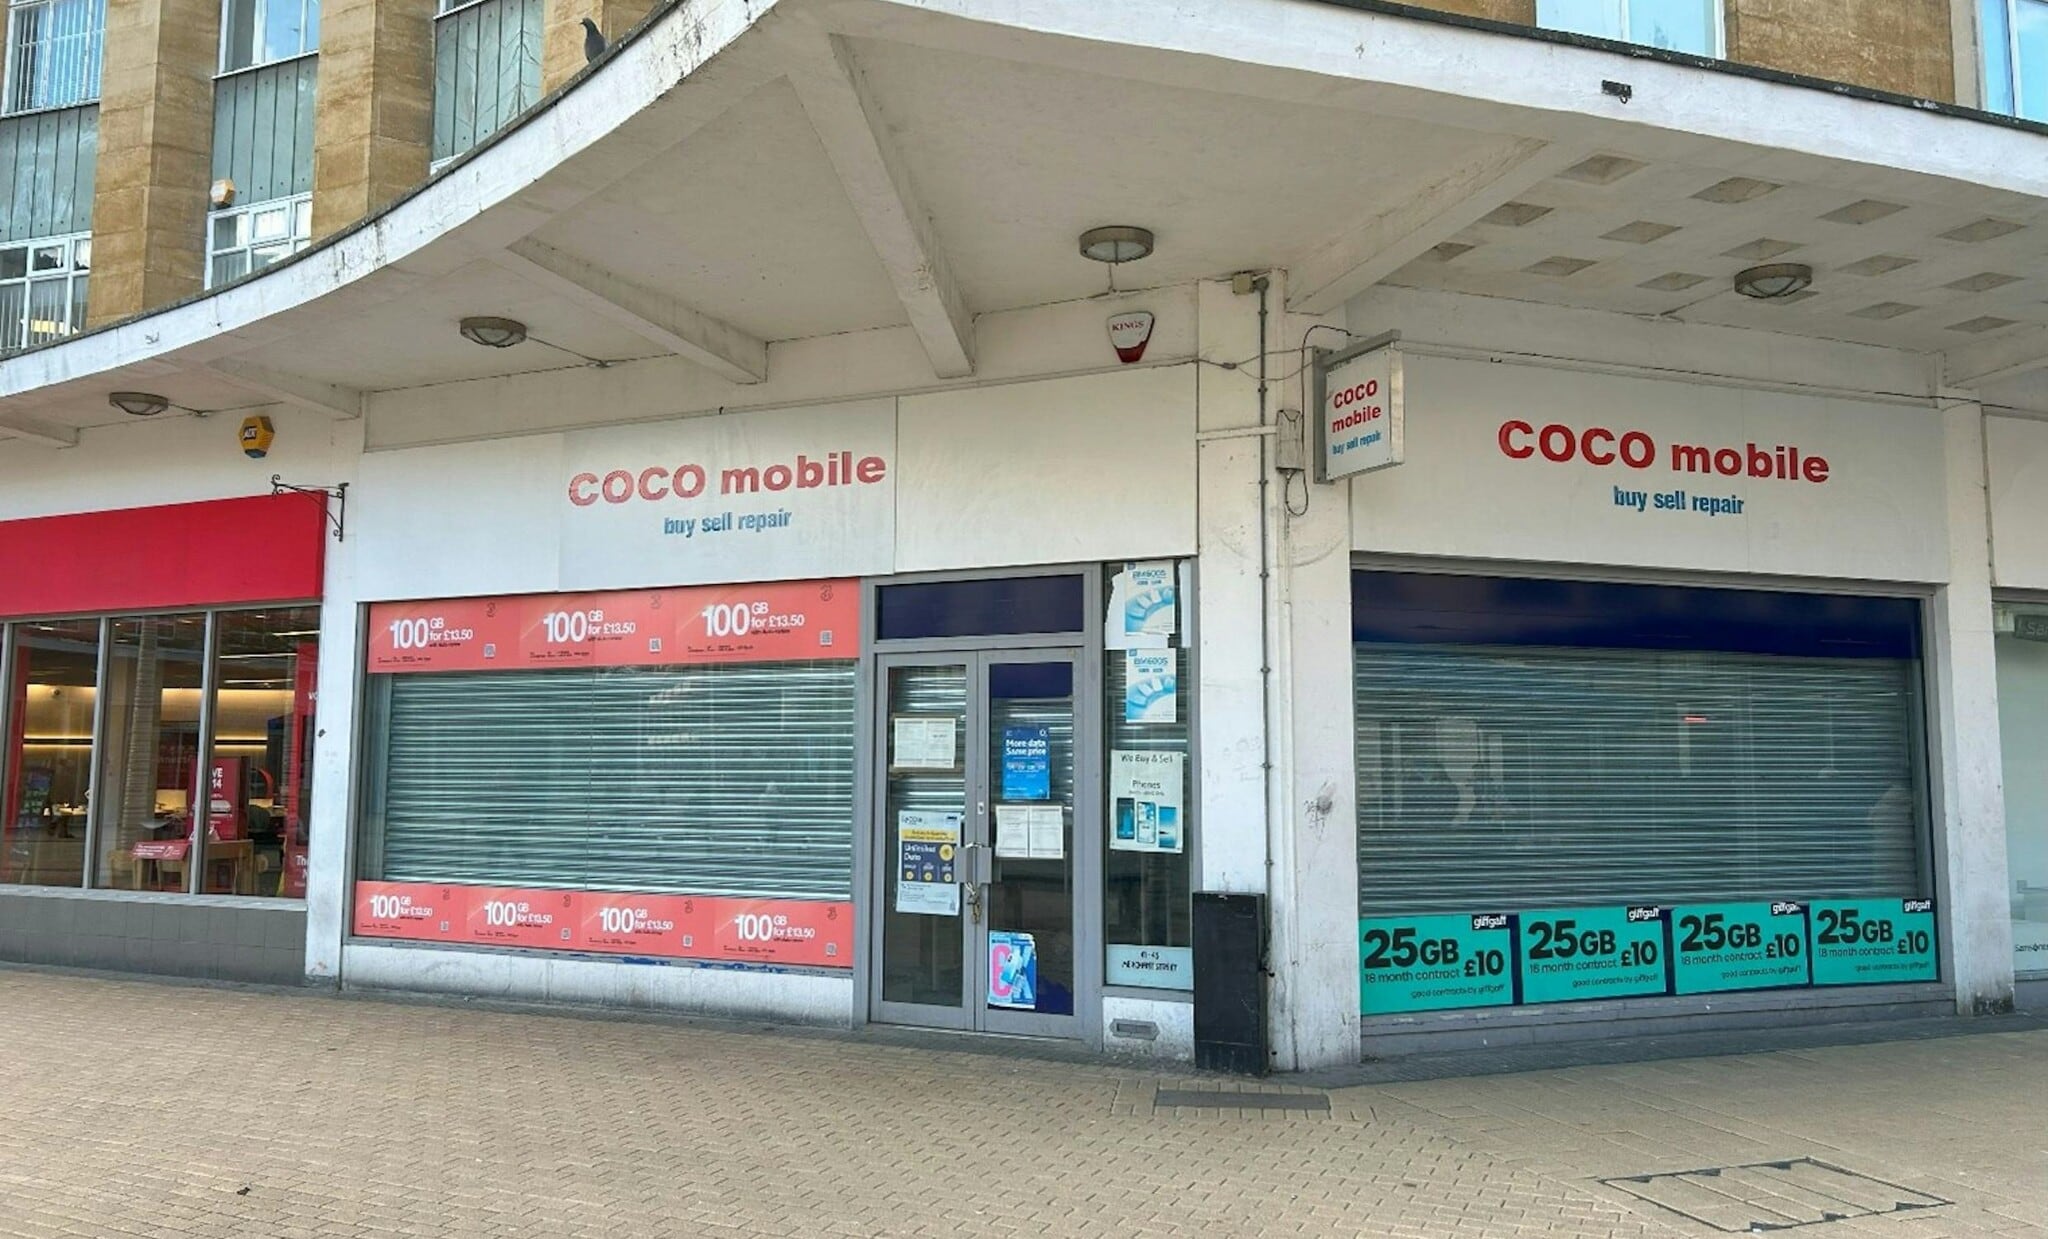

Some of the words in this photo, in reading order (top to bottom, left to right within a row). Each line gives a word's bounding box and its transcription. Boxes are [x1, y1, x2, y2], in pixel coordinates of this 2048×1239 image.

[1112, 321, 1144, 331] KINGS
[1334, 380, 1377, 409] COCO
[1332, 405, 1381, 433] mobile
[1498, 420, 1656, 469] COCO
[1671, 443, 1830, 484] mobile
[568, 464, 706, 507] COCO
[721, 451, 886, 495] mobile
[1613, 486, 1647, 512] buy
[1654, 490, 1686, 511] sell
[1692, 495, 1745, 517] repair
[664, 516, 696, 538] buy
[702, 512, 732, 532] sell
[738, 508, 792, 532] repair
[543, 611, 587, 642] 100
[588, 610, 604, 622] GB
[588, 624, 602, 635] for
[604, 622, 636, 634] £13.50
[702, 603, 750, 637] 100
[752, 602, 769, 615] GB
[751, 616, 766, 628] for
[769, 614, 805, 627] £13.50
[389, 618, 428, 649] 100
[430, 617, 444, 629] GB
[429, 631, 442, 641] for
[443, 629, 474, 641] £13.50
[1006, 739, 1027, 748] More
[1028, 738, 1047, 748] data
[1006, 747, 1027, 756] Same
[1028, 748, 1047, 757] price
[1135, 755, 1150, 764] Buy
[1132, 780, 1161, 789] Phones
[369, 895, 400, 918] 100
[484, 901, 516, 926] 100
[1629, 907, 1660, 921] giffgaff
[1904, 900, 1931, 912] giffgaff
[599, 907, 634, 933] 100
[734, 914, 773, 941] 100
[773, 915, 787, 925] GB
[773, 927, 785, 936] for
[1473, 916, 1507, 929] giffgaff
[1621, 940, 1658, 967] £10
[1766, 933, 1800, 959] £10
[1818, 948, 1828, 958] 18
[1830, 947, 1857, 958] month
[1859, 947, 1895, 956] contract
[1897, 930, 1929, 955] £10
[1464, 950, 1504, 977] £10
[1529, 964, 1539, 974] 18
[1542, 961, 1574, 973] month
[1576, 959, 1617, 971] contract
[1681, 956, 1691, 965] 18
[1692, 953, 1722, 964] month
[1724, 951, 1763, 962] contract
[1365, 973, 1376, 984] 18
[1378, 971, 1413, 982] month
[1415, 969, 1461, 981] contract
